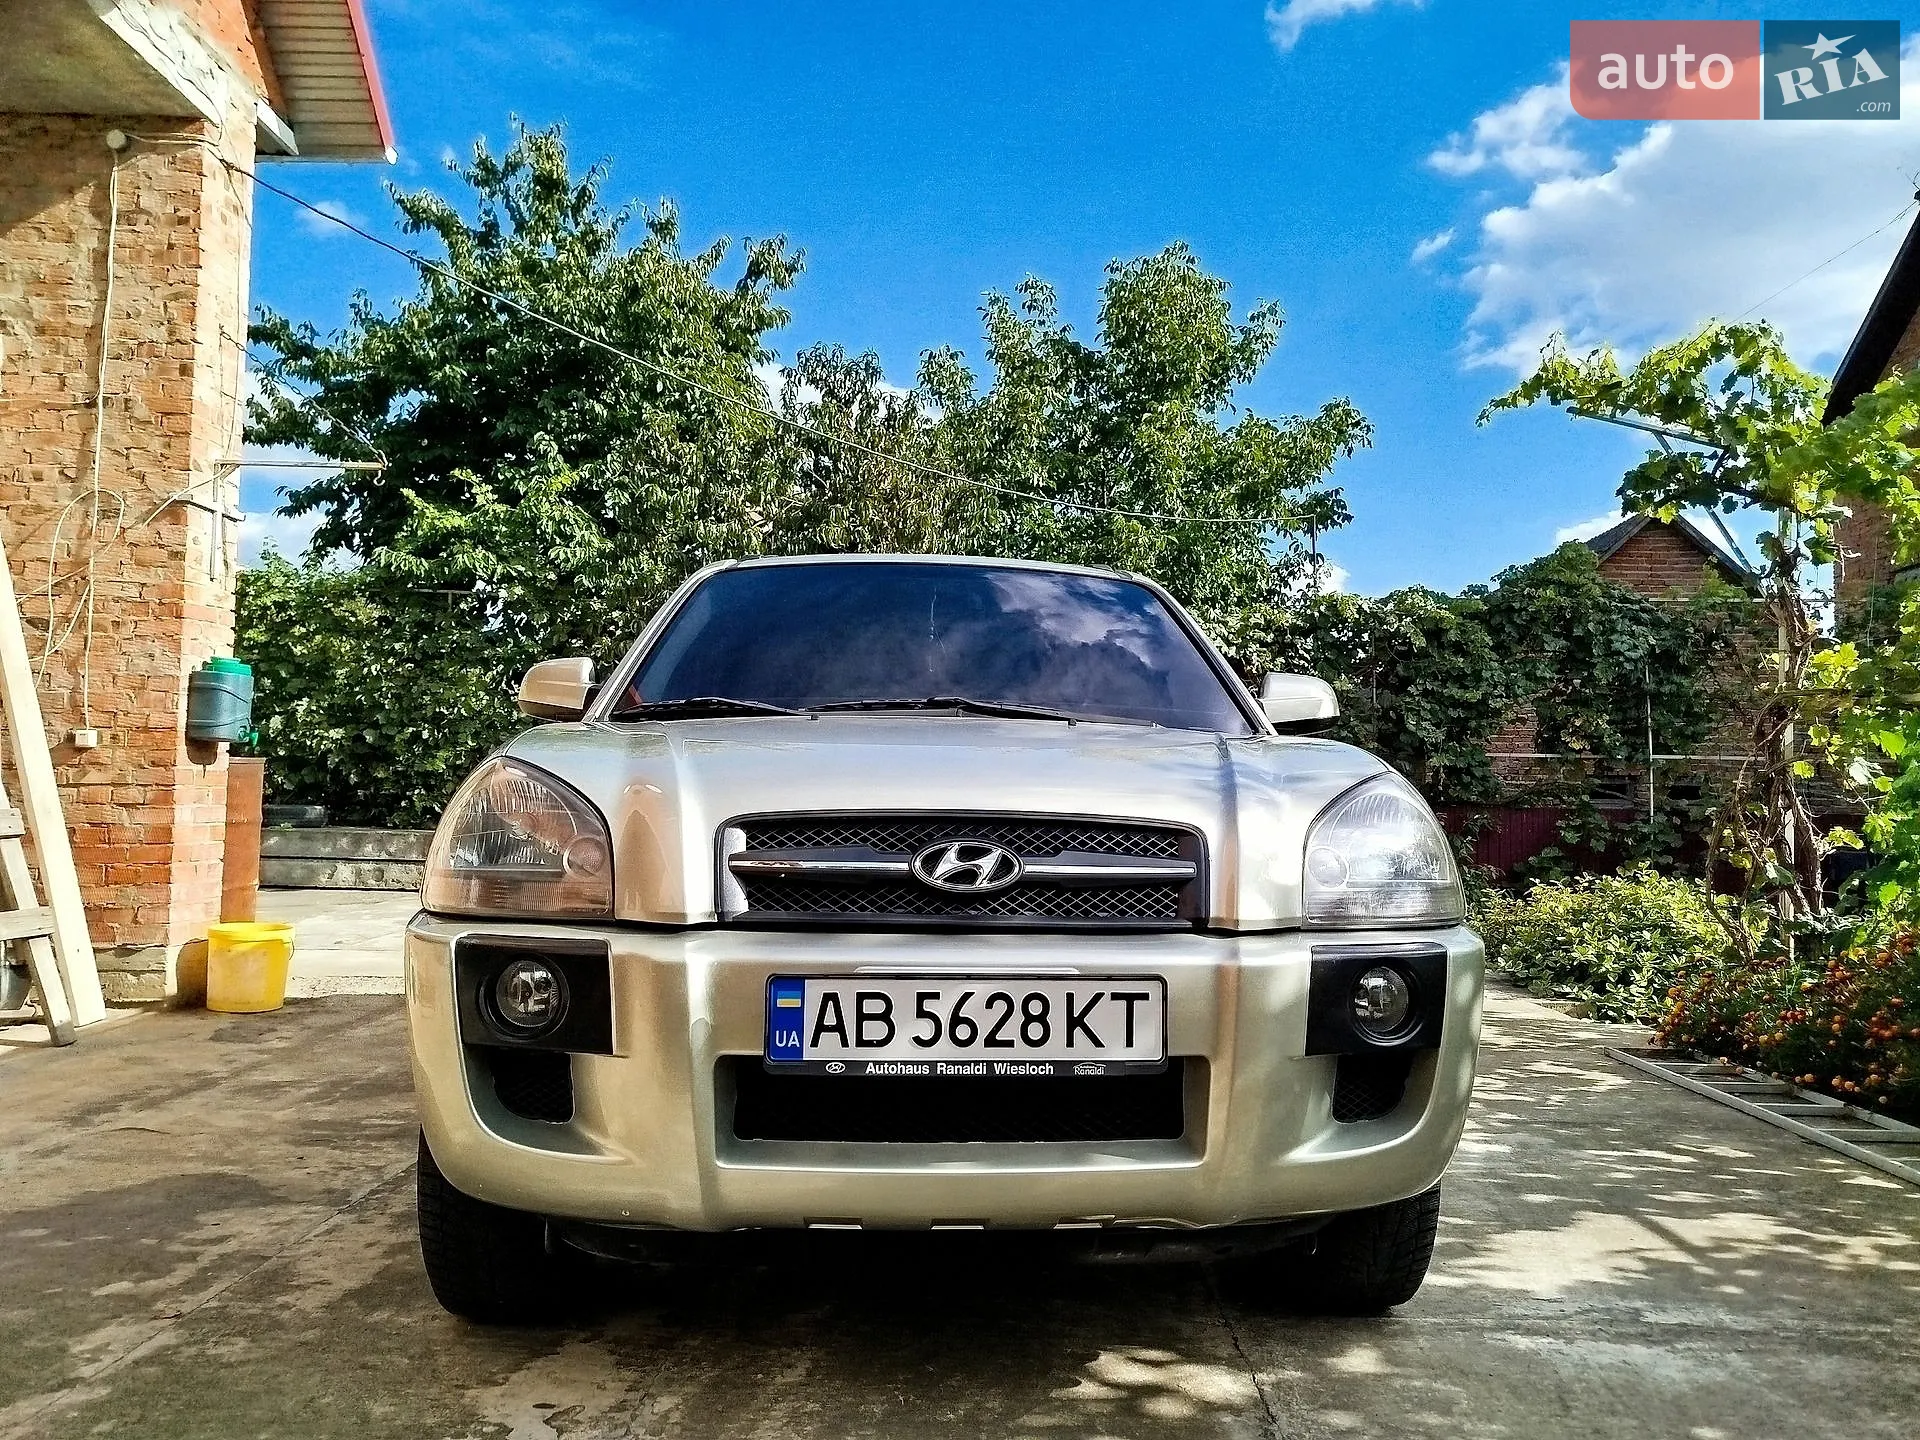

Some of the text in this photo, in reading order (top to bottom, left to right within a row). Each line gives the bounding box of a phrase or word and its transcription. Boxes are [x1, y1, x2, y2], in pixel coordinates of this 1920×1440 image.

[809, 991, 1151, 1049] AB 5628 KT
[775, 1031, 800, 1048] UA
[865, 1062, 1054, 1075] Autohaus Ranaldi Wiesloch
[1074, 1066, 1105, 1075] Ranaldi
